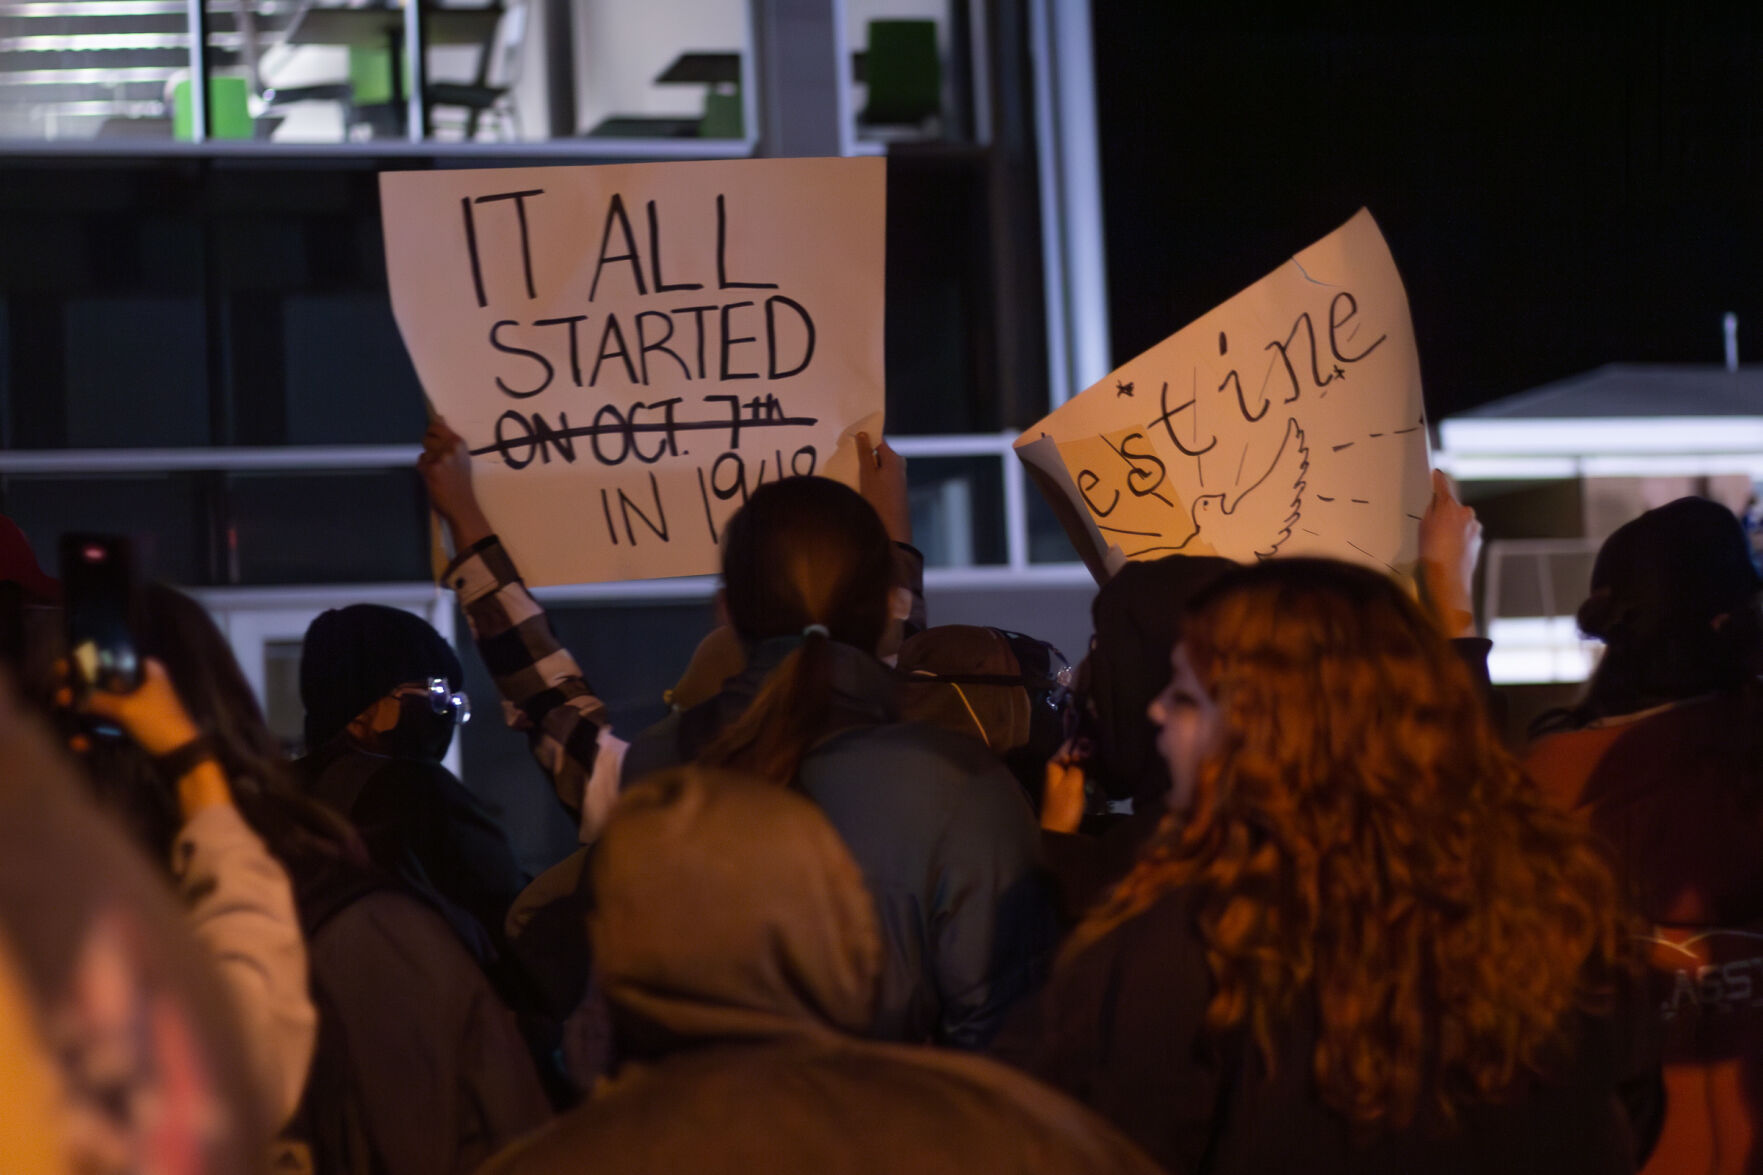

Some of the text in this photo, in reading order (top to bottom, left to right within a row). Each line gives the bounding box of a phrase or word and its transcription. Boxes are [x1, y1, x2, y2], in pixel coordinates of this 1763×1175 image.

[461, 189, 779, 308] IT ALL
[490, 295, 816, 399] STARTED
[495, 409, 576, 470] ON
[600, 471, 669, 546] IN
